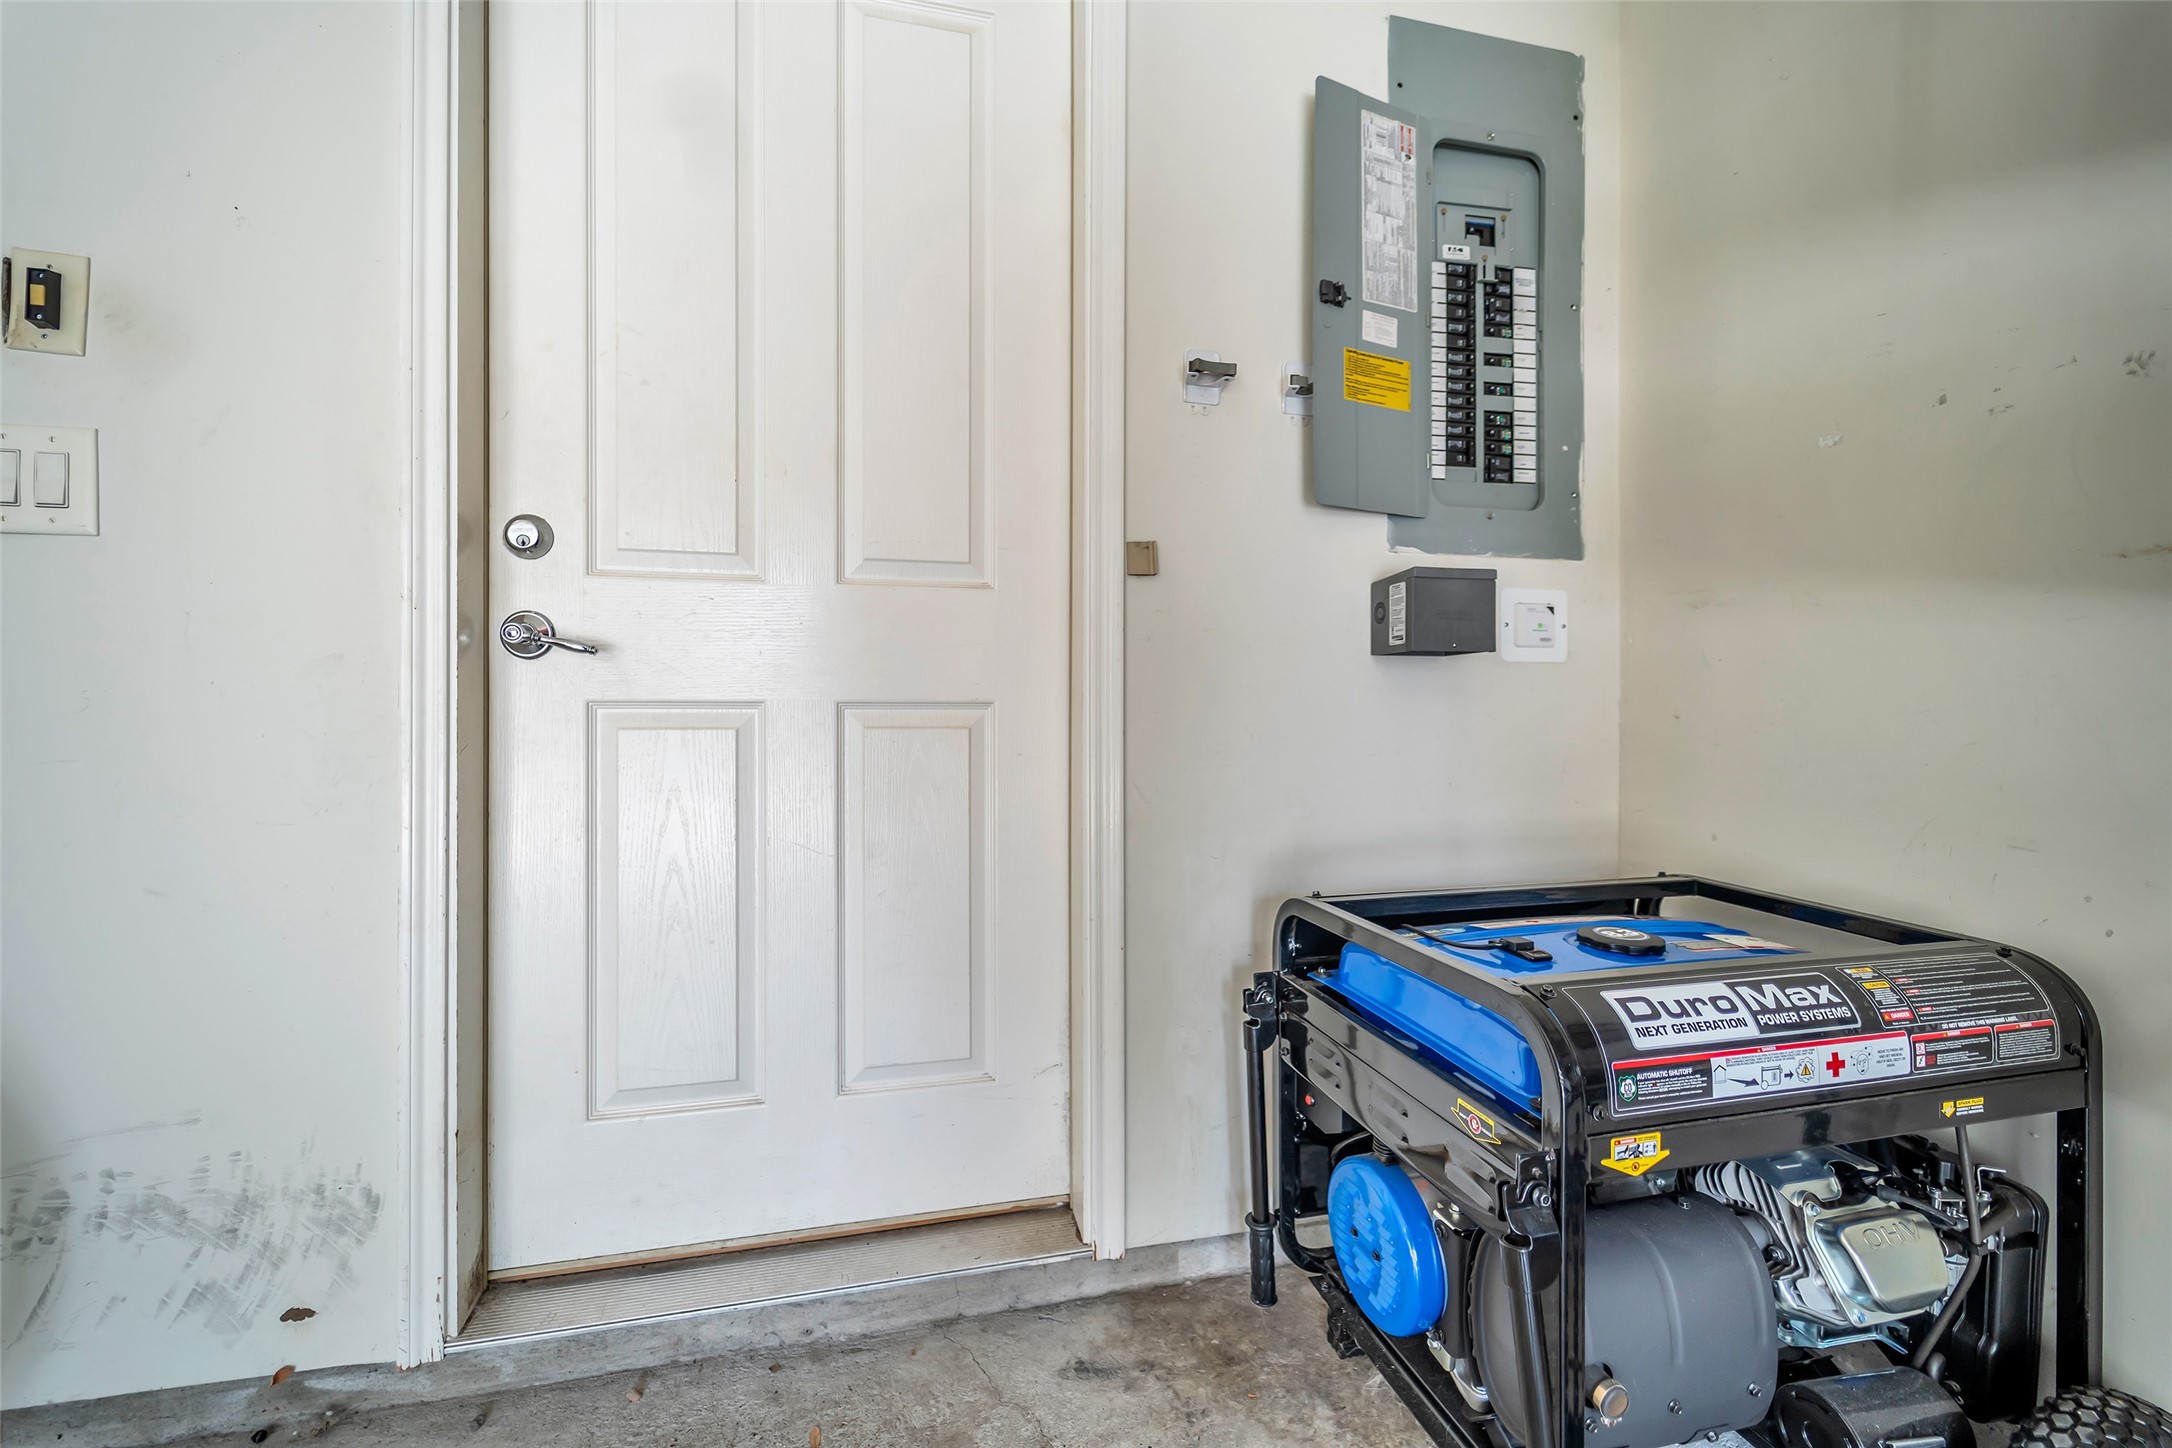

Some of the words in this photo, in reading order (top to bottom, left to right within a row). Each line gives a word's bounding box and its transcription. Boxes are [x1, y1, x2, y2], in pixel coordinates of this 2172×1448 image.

[1613, 994, 1740, 1024] Duro
[1734, 983, 1842, 1011] Max
[1757, 1011, 1799, 1026] POWER
[1801, 1007, 1851, 1021] SYSTEMS
[1635, 1025, 1668, 1038] NEXT
[1672, 1017, 1748, 1035] GENERATION
[1637, 1070, 1668, 1080] AUTOMATIC
[1668, 1068, 1693, 1076] SHUTOFF
[1863, 1218, 1920, 1249] OHV
